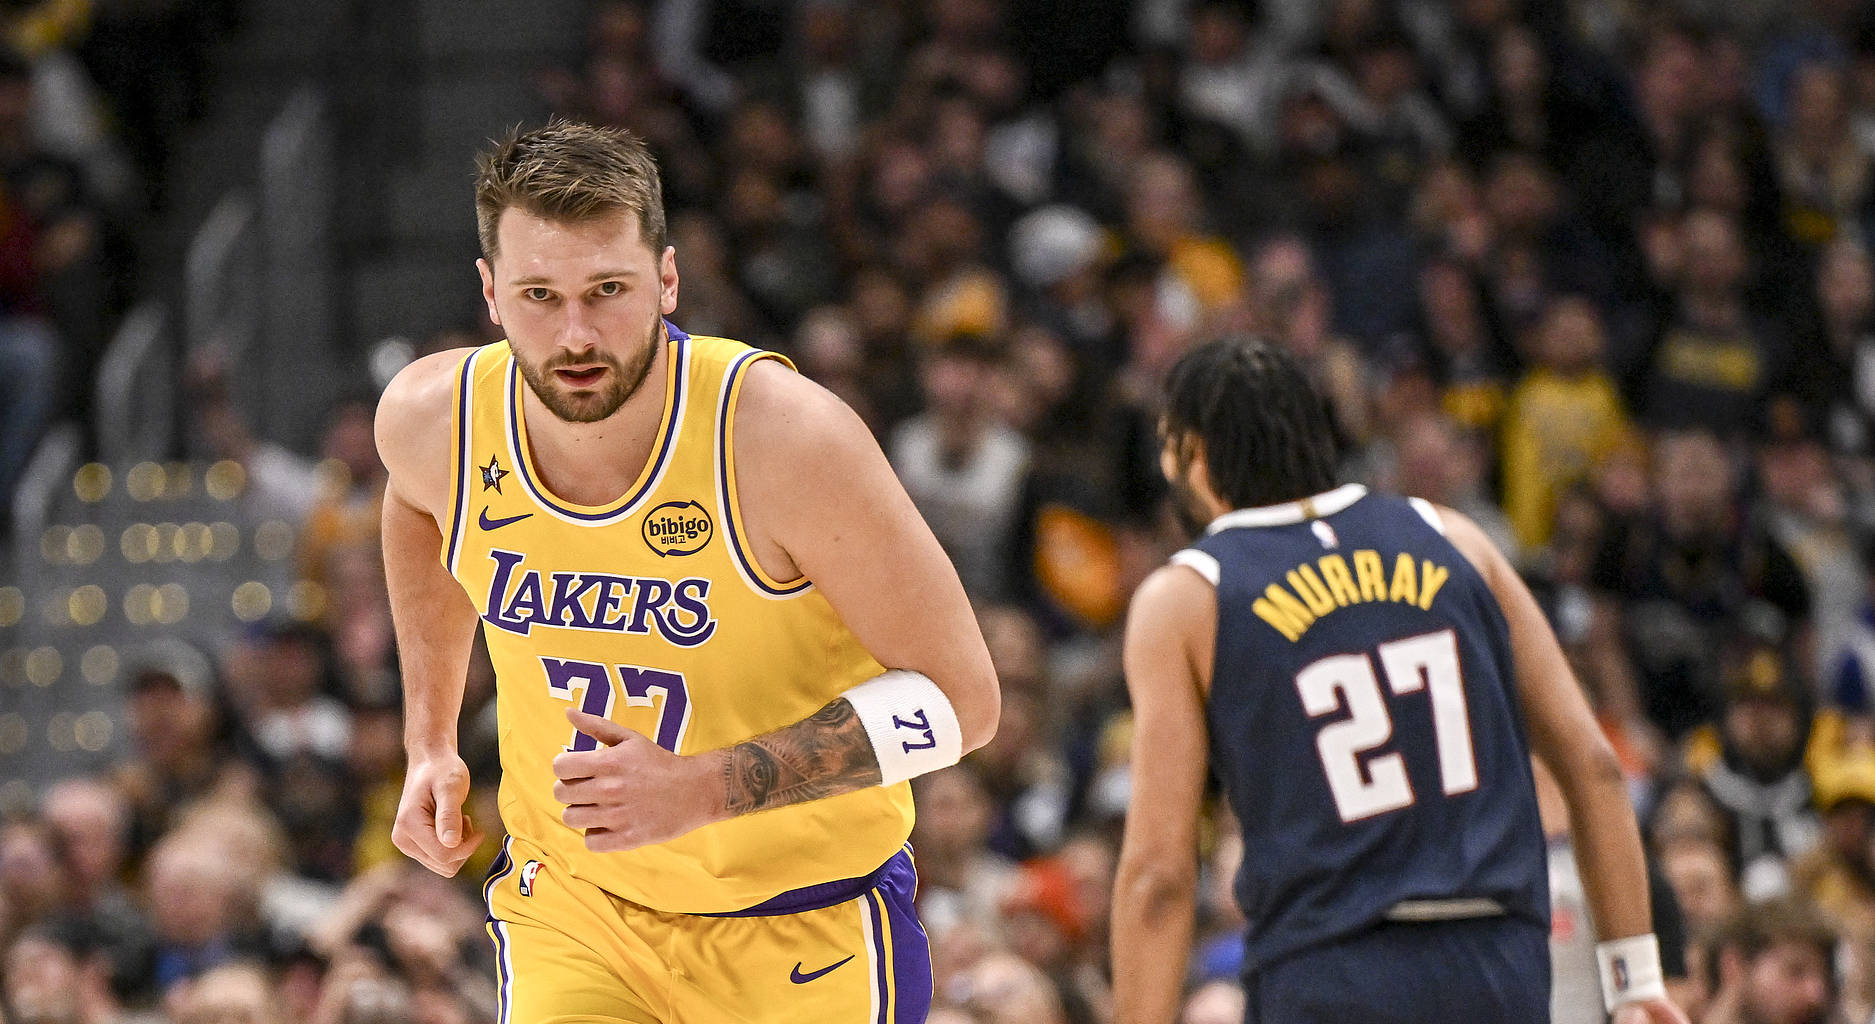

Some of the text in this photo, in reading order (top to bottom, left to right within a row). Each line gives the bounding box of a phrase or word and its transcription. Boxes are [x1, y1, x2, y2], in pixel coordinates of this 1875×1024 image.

[648, 516, 709, 539] bibigo
[661, 535, 687, 545] 비비고
[480, 548, 719, 648] LAKERS
[1252, 549, 1449, 643] MURRAY
[537, 656, 693, 755] 77
[892, 708, 936, 754] 77
[1295, 628, 1479, 825] 27
